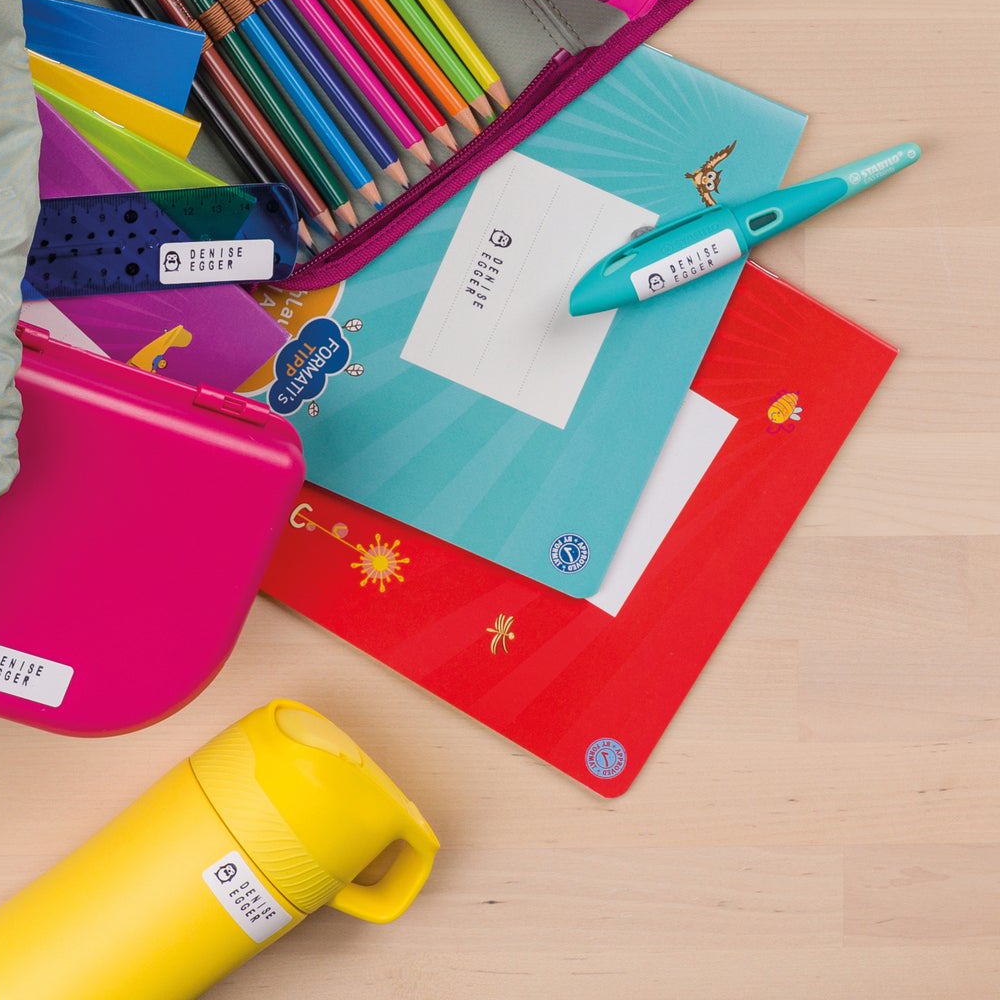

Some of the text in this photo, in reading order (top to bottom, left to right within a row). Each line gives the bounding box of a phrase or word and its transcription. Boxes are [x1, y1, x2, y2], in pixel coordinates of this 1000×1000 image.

[190, 246, 243, 260] DENISE
[190, 260, 234, 272] EGGER
[669, 244, 719, 273] DENISE
[465, 252, 492, 295] EGGER
[472, 257, 503, 309] DENISE
[674, 259, 714, 282] EGGER
[278, 338, 340, 404] FORMATI's
[286, 343, 317, 377] TIPP
[567, 542, 588, 571] APPROVED
[602, 748, 624, 776] APPROVED
[229, 889, 260, 923] EGGER
[239, 881, 276, 920] DENISE
